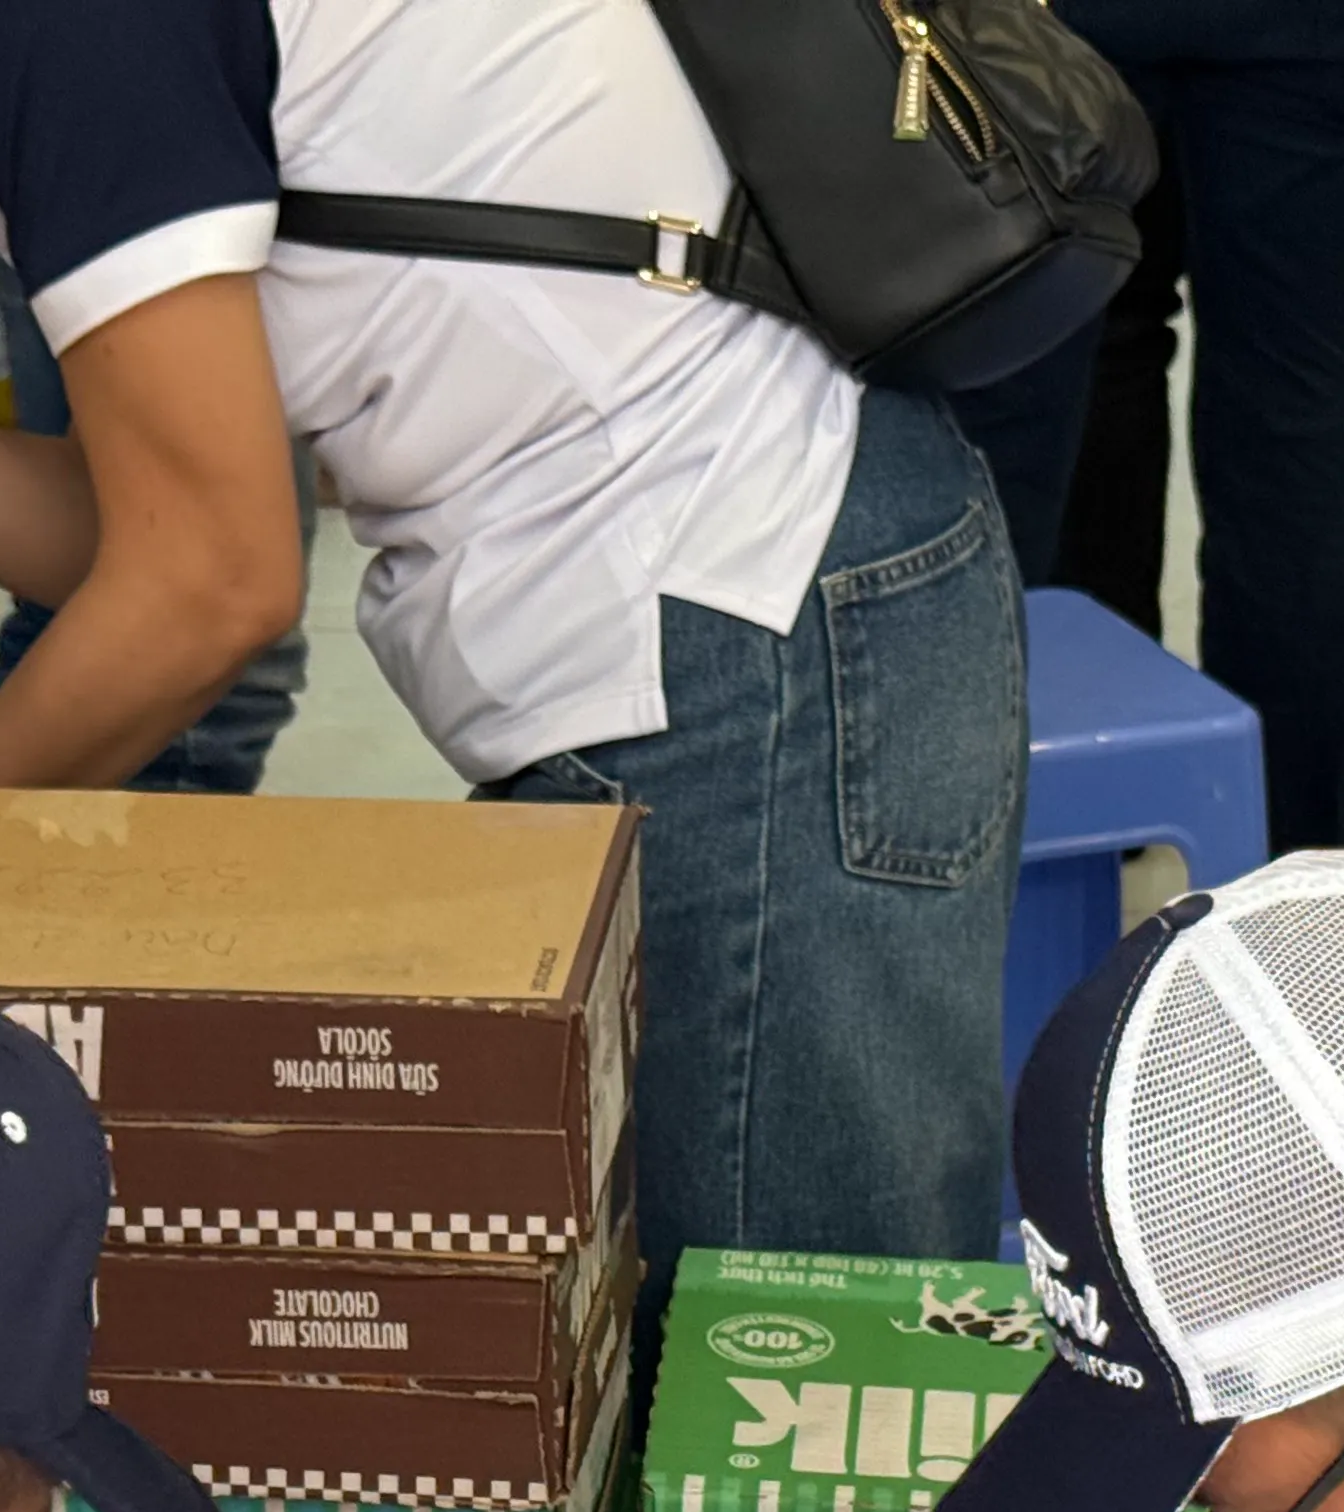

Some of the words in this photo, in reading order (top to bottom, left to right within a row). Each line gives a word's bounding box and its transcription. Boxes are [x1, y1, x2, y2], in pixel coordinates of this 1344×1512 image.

[347, 1062, 396, 1090] DINH
[398, 1062, 440, 1097] SỮA
[273, 1287, 381, 1318] CHOCOLATE
[248, 1317, 297, 1347] MILK
[299, 1319, 409, 1350] NUTRITIOUS
